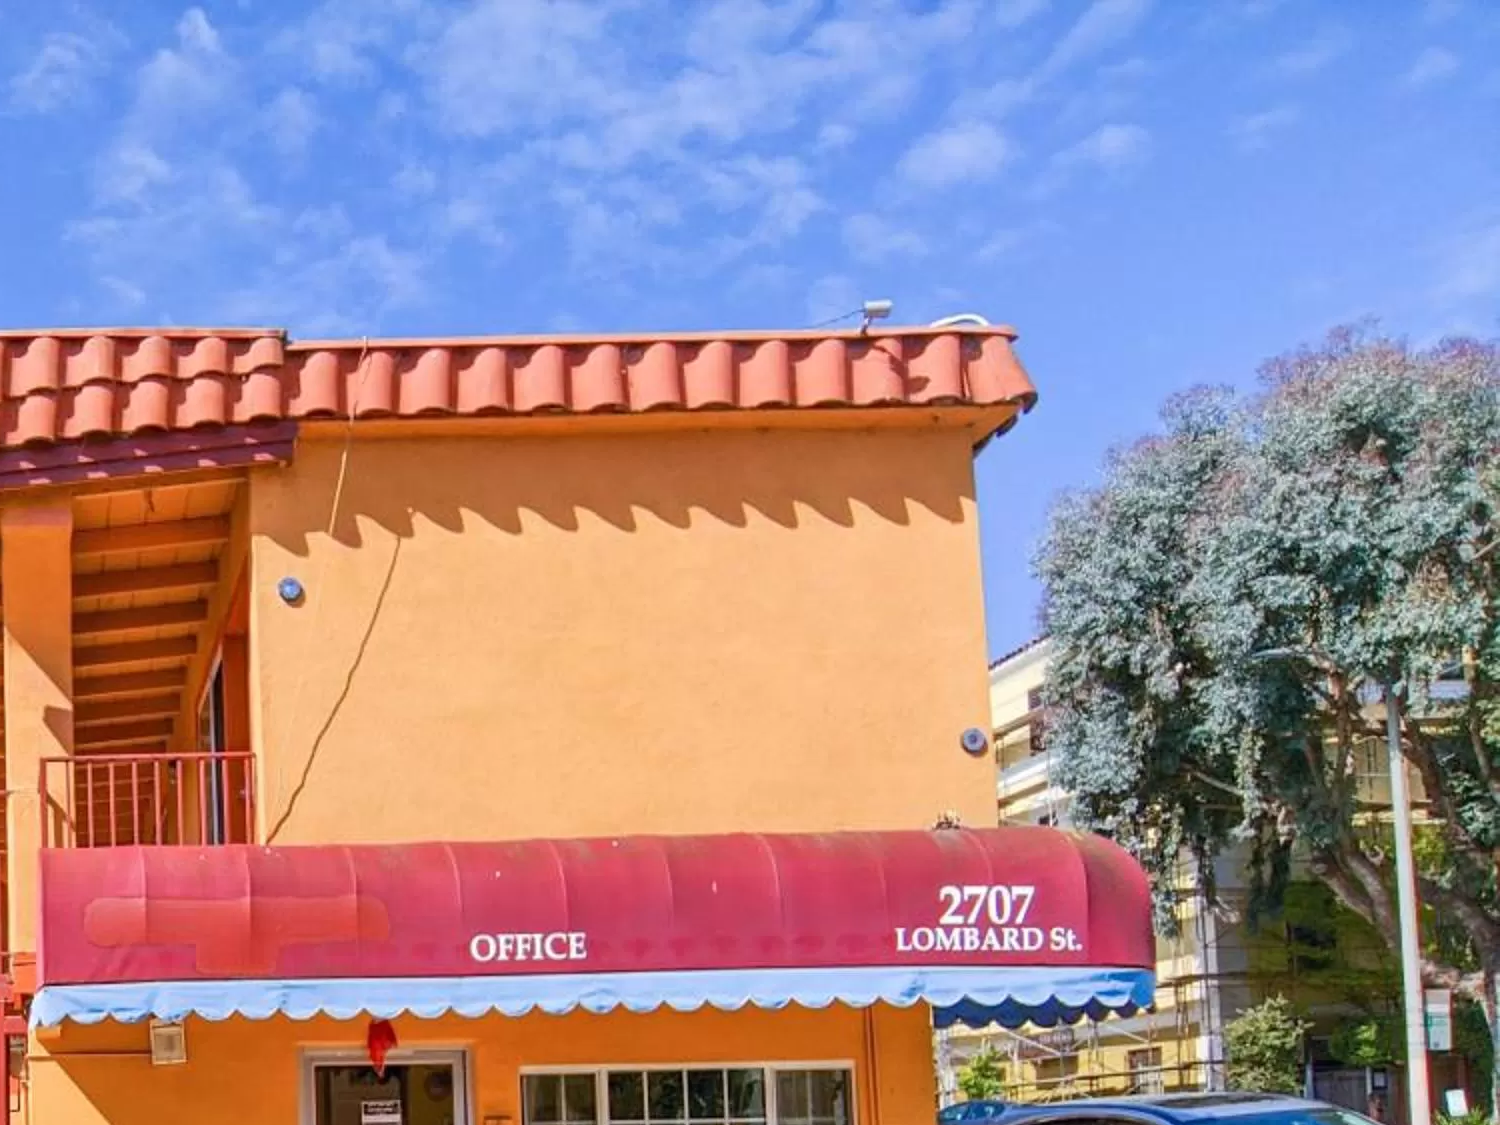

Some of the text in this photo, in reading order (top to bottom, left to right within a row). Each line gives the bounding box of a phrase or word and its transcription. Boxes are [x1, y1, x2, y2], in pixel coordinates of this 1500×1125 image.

[939, 885, 1035, 925] 2707
[470, 931, 588, 961] OFFICE
[895, 926, 1083, 951] LOMBARD St.
